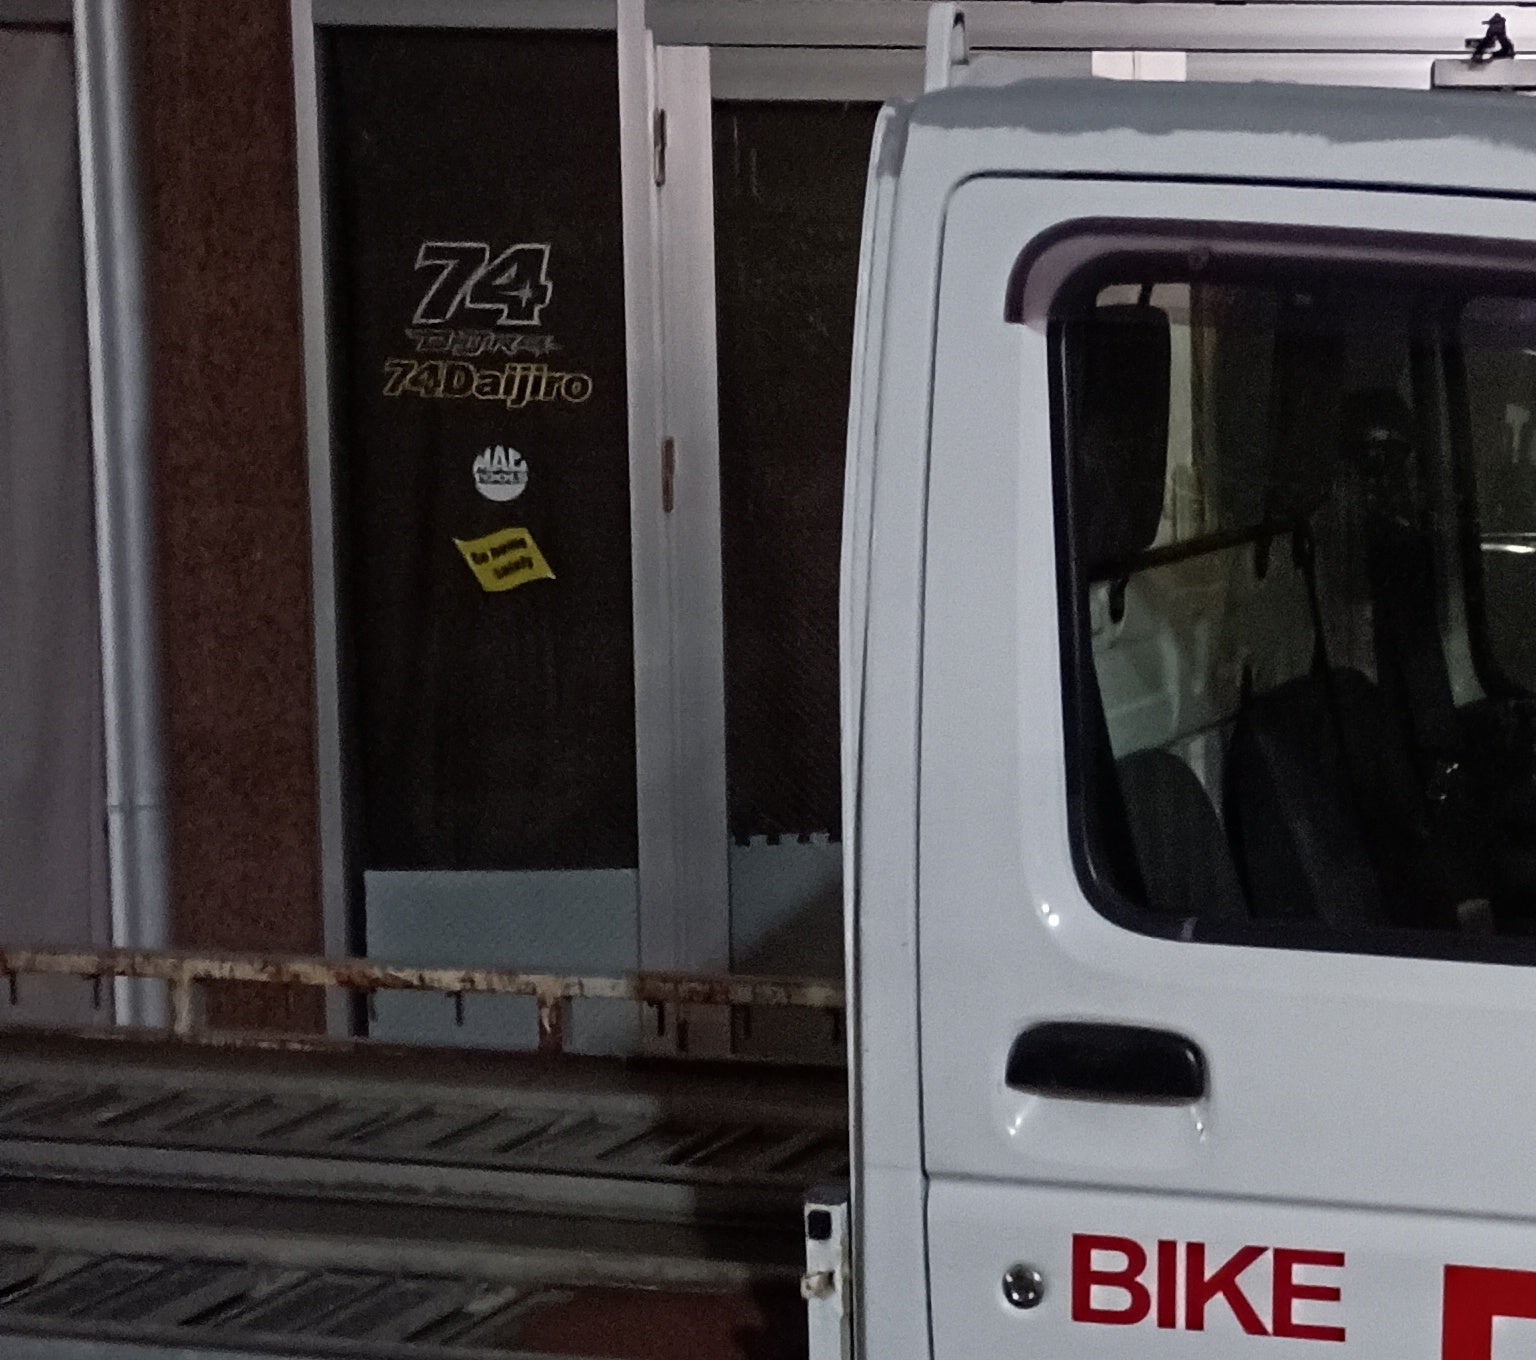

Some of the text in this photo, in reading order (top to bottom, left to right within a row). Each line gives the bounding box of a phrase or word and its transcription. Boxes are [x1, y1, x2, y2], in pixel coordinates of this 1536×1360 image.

[413, 240, 553, 326] 74
[383, 358, 593, 410] 74Daijiro
[1070, 1233, 1346, 1342] BIKE
